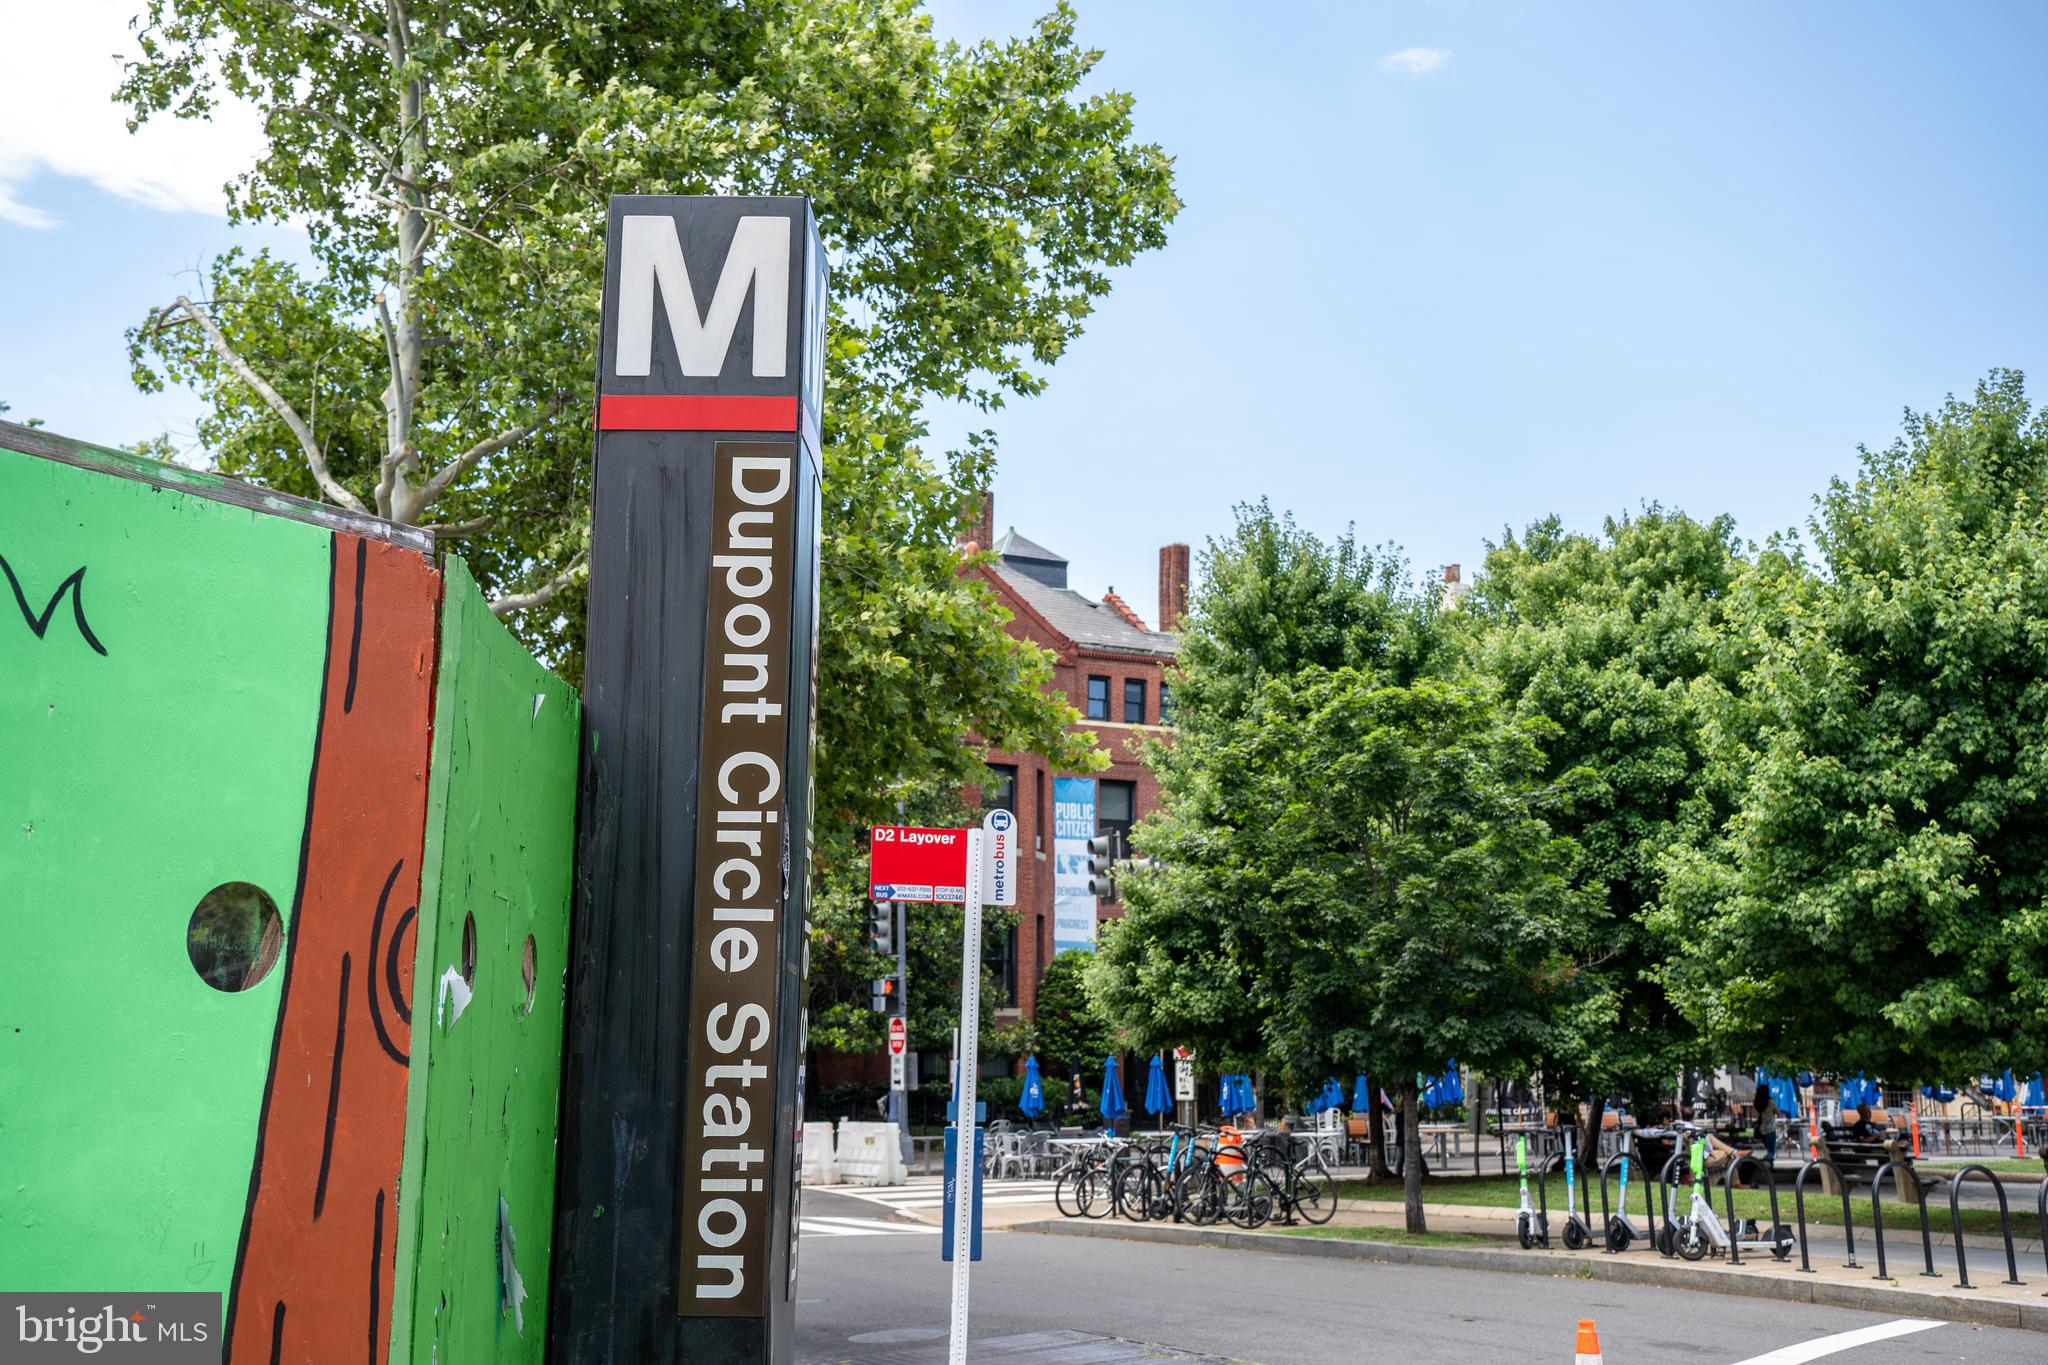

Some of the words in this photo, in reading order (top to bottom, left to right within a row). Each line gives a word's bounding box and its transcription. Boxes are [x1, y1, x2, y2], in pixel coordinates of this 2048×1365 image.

[615, 215, 791, 377] M
[712, 457, 791, 725] Dupont
[875, 829, 895, 842] D2
[900, 831, 956, 845] Layover
[1056, 802, 1094, 820] PUBLIC
[1056, 820, 1094, 838] CITIZEN
[709, 751, 781, 973] Circle
[993, 834, 1005, 901] metrobus
[1056, 919, 1089, 931] PROGRESS
[695, 1002, 771, 1299] Station
